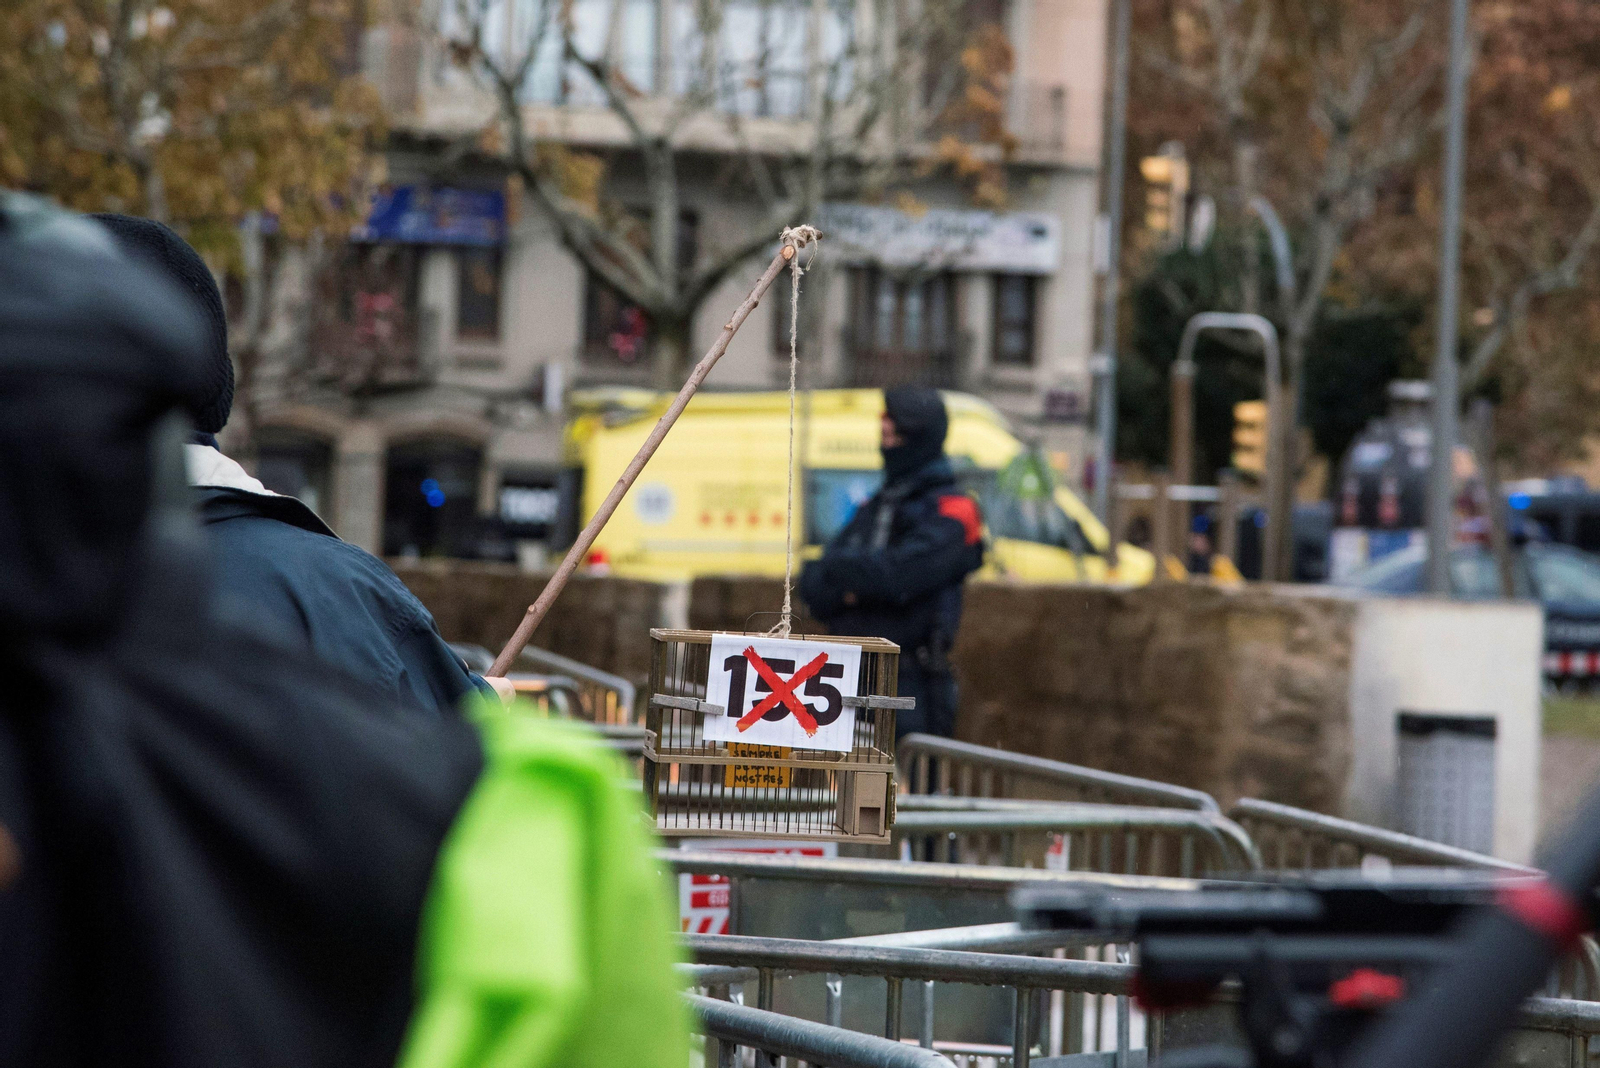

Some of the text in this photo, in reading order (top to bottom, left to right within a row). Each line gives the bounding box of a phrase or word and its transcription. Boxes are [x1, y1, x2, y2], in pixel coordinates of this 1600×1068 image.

[724, 655, 844, 726] 155
[733, 749, 780, 759] SEMPRE
[735, 774, 784, 785] NOSTRES
